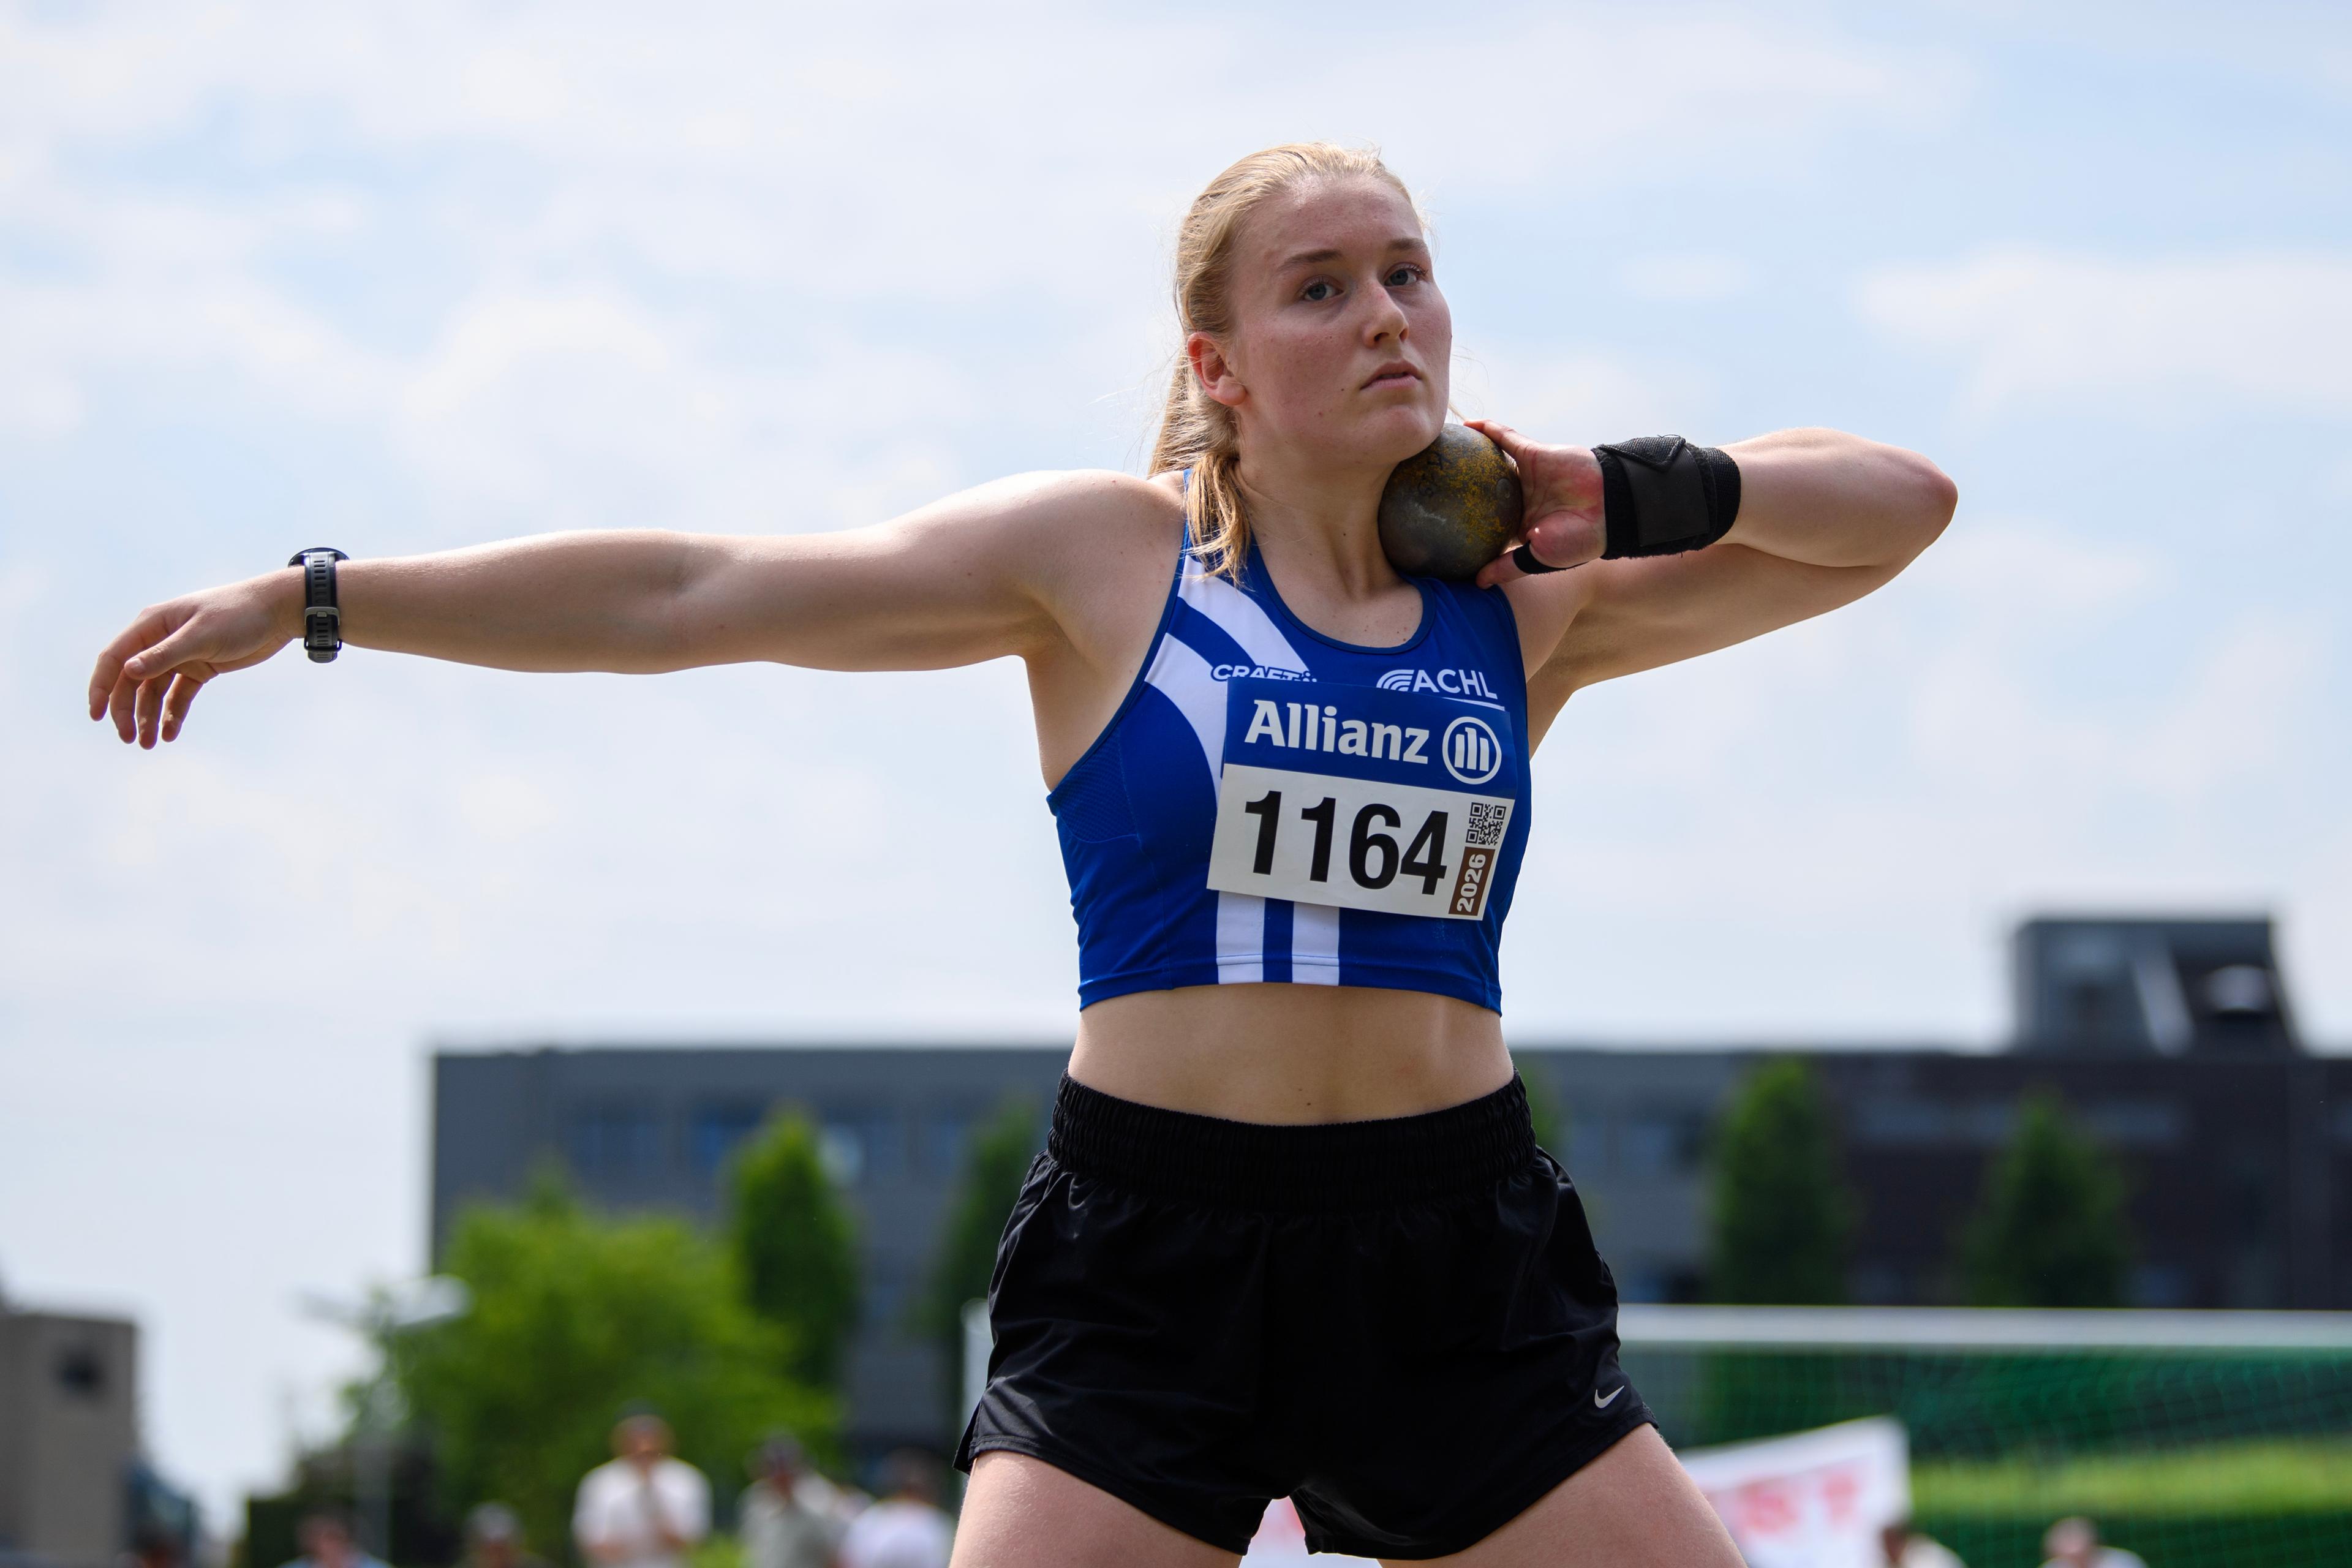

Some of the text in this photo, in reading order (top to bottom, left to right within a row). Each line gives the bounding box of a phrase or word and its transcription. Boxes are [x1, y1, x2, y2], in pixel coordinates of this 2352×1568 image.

[1412, 669, 1498, 699] ACHL
[1244, 699, 1430, 764] Allianz
[1245, 790, 1449, 895] 1164
[1456, 854, 1486, 913] 2026
